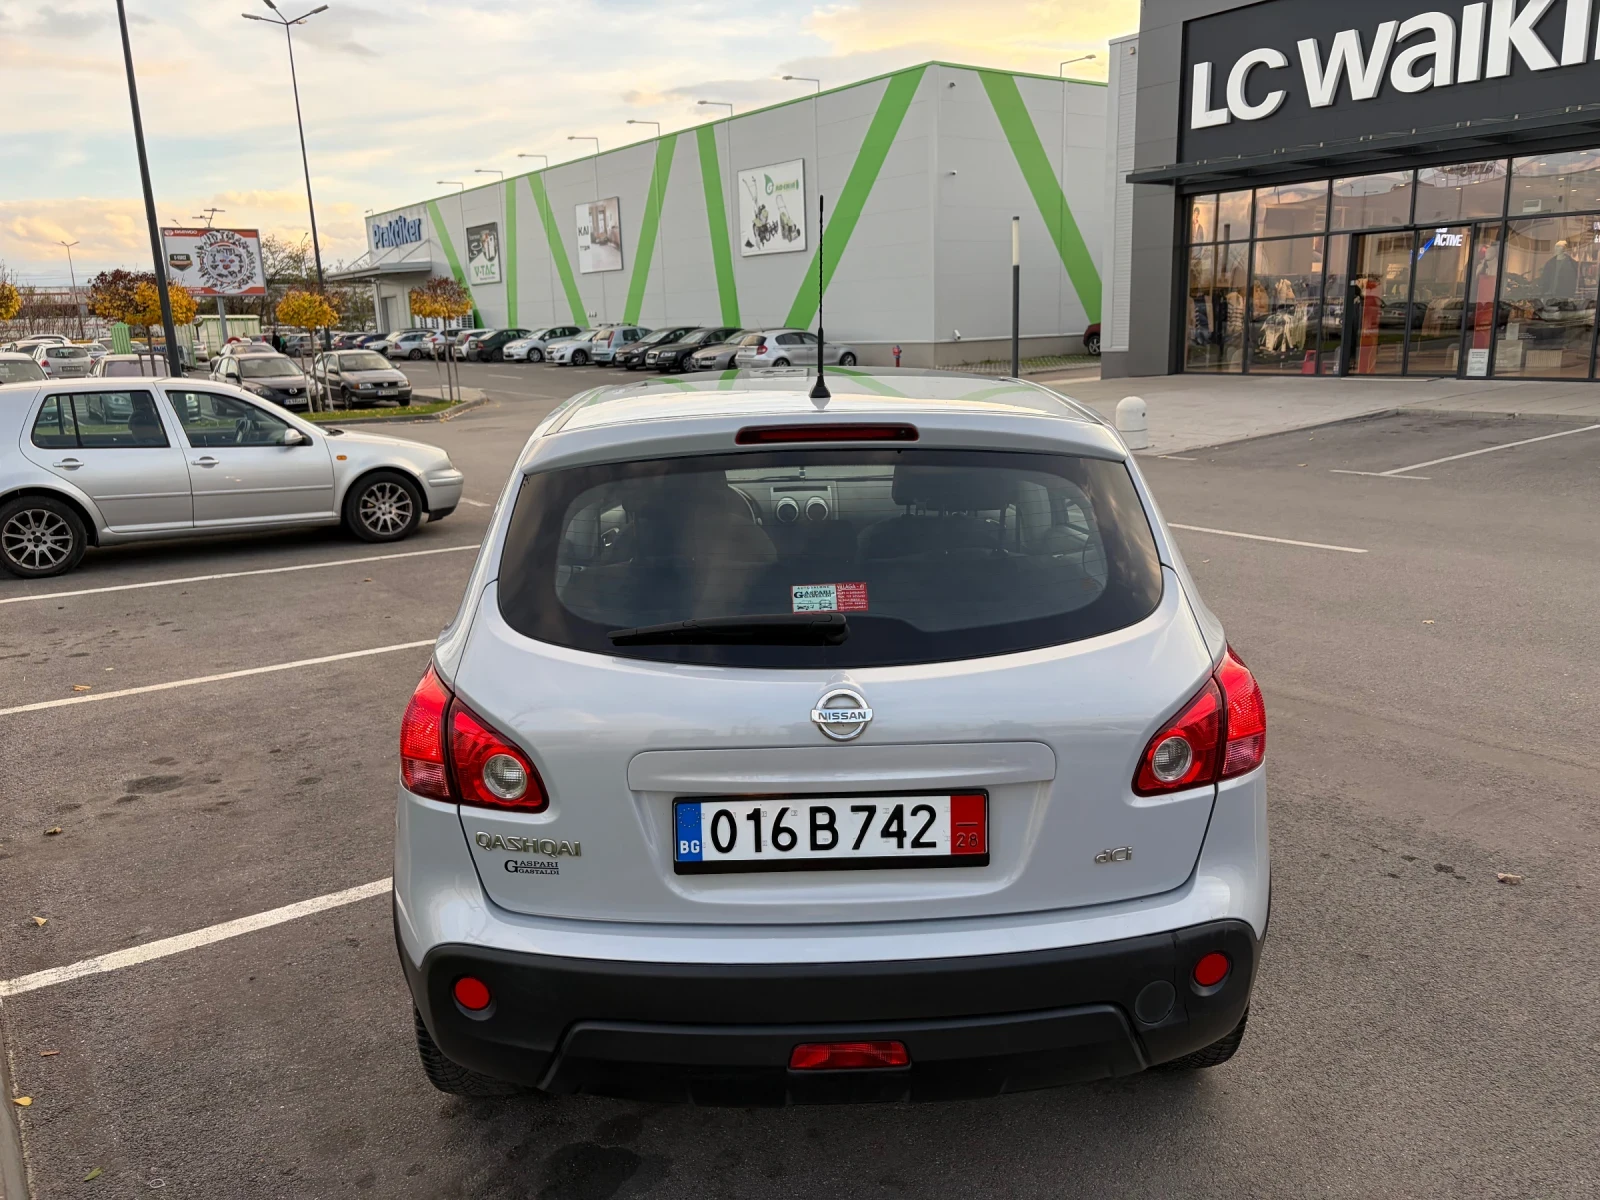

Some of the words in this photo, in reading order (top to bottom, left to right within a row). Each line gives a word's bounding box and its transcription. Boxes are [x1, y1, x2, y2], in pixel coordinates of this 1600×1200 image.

[1190, 47, 1288, 129] LC
[372, 216, 422, 249] Praktiker
[818, 711, 866, 720] NISSAN
[475, 831, 582, 858] QASHQAI
[680, 840, 701, 854] BG
[1095, 845, 1133, 864] dCi
